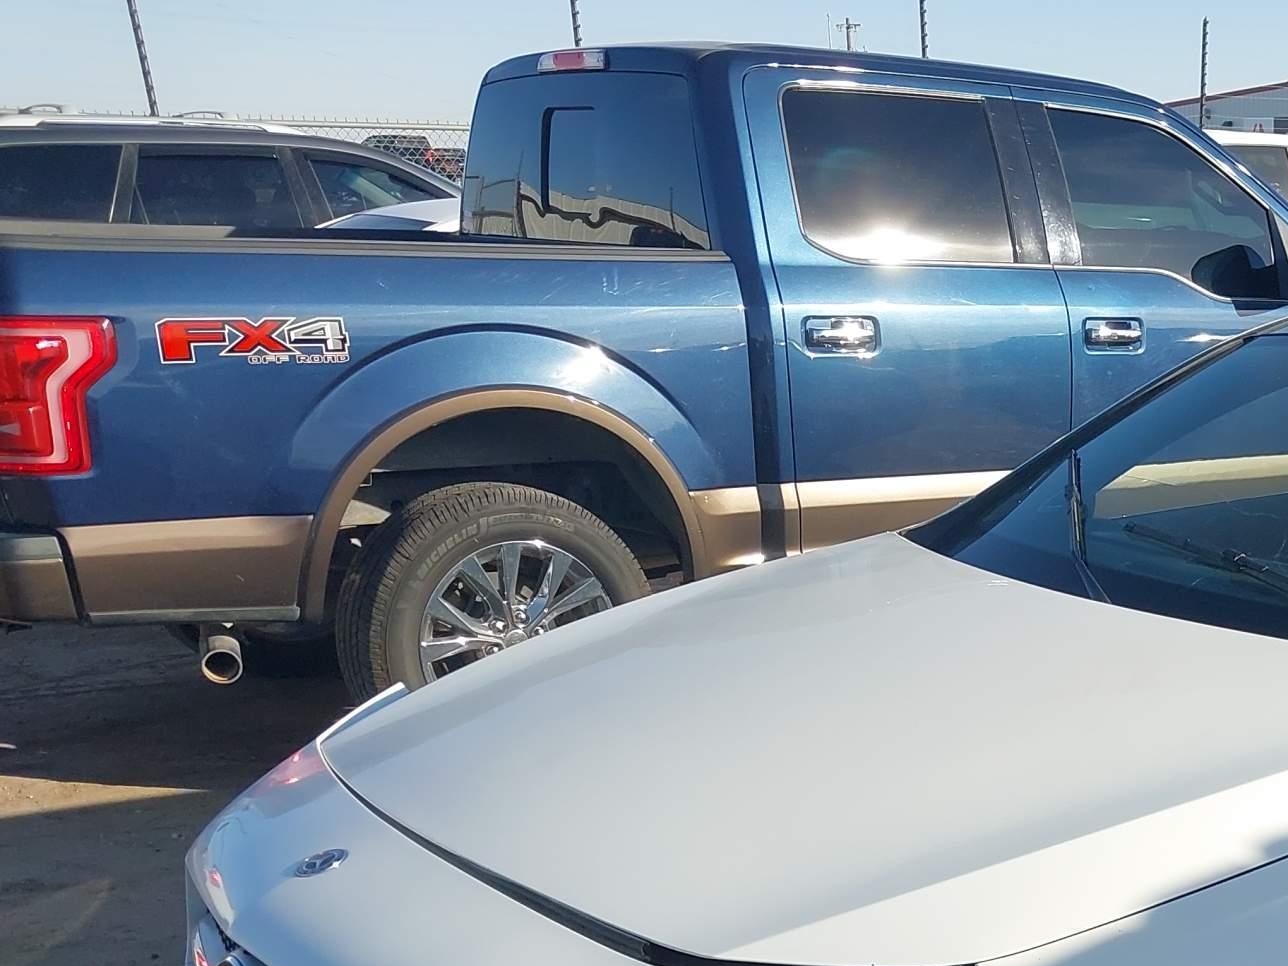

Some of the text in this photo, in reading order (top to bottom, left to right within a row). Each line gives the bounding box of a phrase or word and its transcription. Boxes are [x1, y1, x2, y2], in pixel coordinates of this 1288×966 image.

[155, 317, 350, 364] FX4
[248, 353, 351, 365] OFF ROAD
